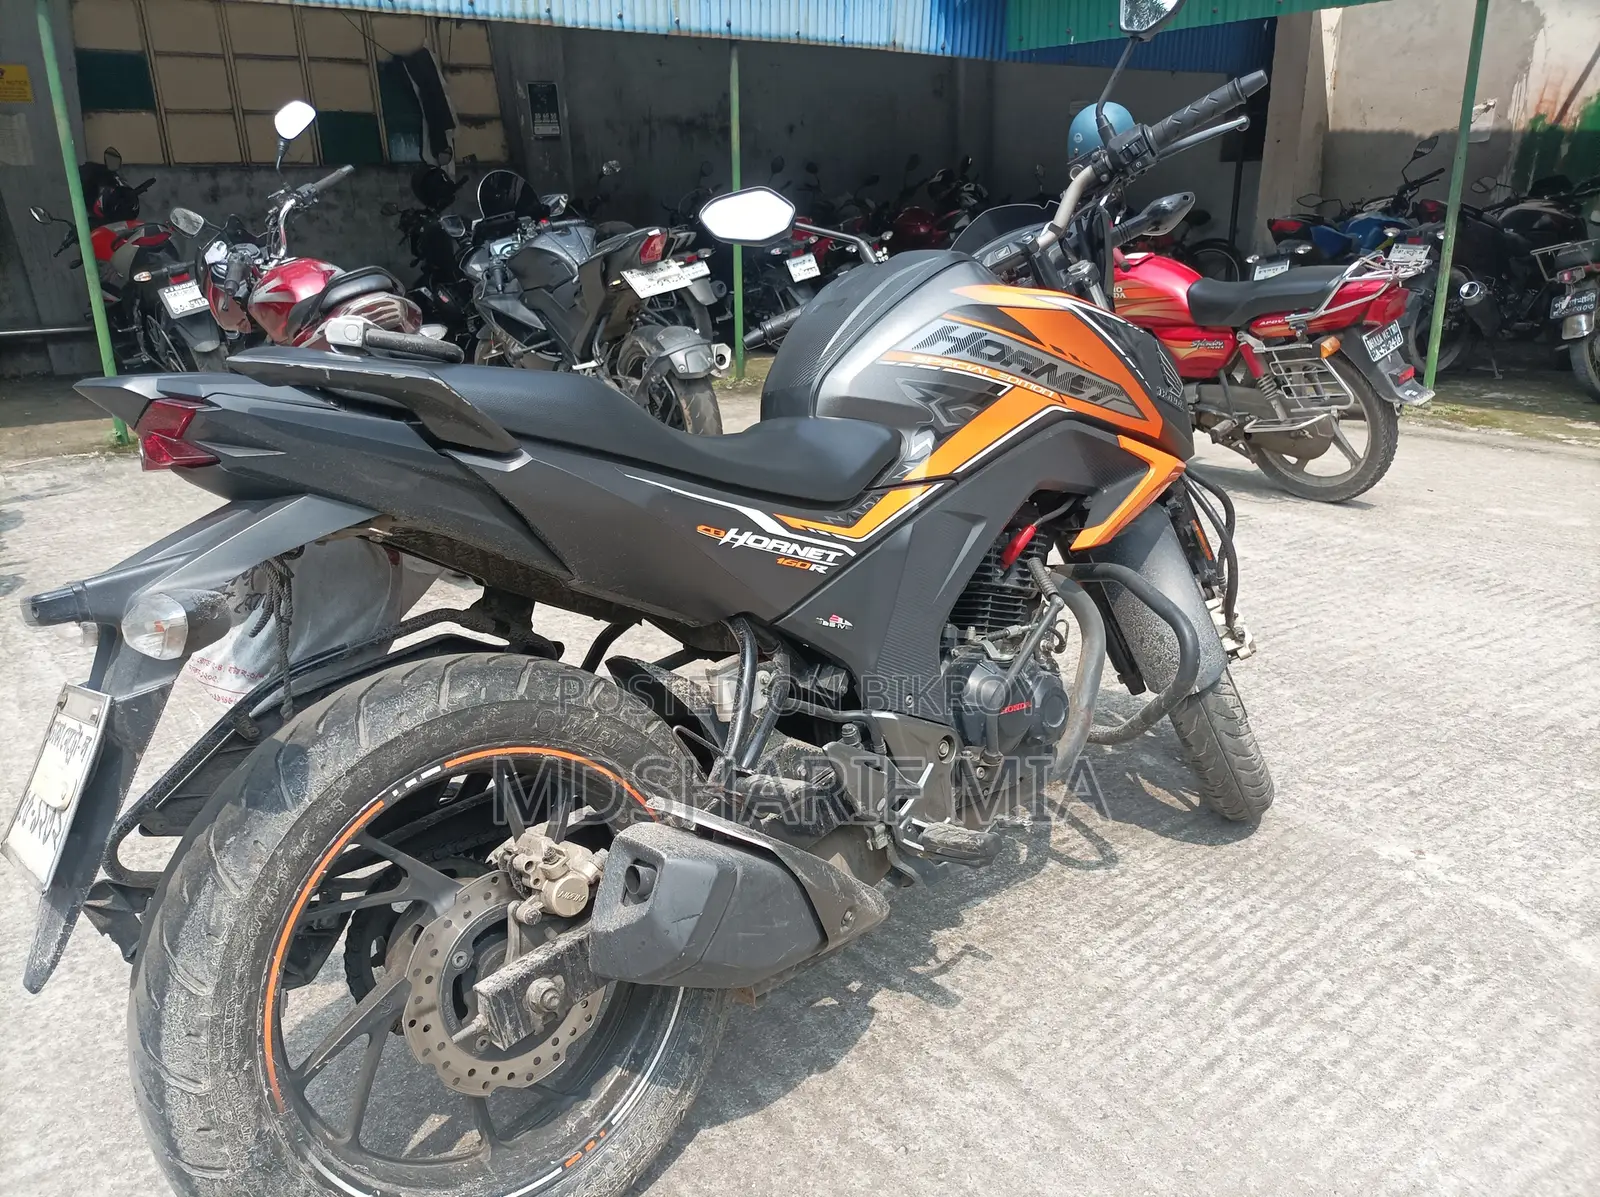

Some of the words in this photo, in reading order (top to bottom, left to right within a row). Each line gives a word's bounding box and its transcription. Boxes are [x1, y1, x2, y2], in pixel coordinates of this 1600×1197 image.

[911, 324, 1126, 402] HORNET
[911, 355, 992, 378] SPECIAL
[997, 371, 1055, 398] EDITION
[718, 527, 844, 564] HORNET
[776, 556, 829, 575] 160R
